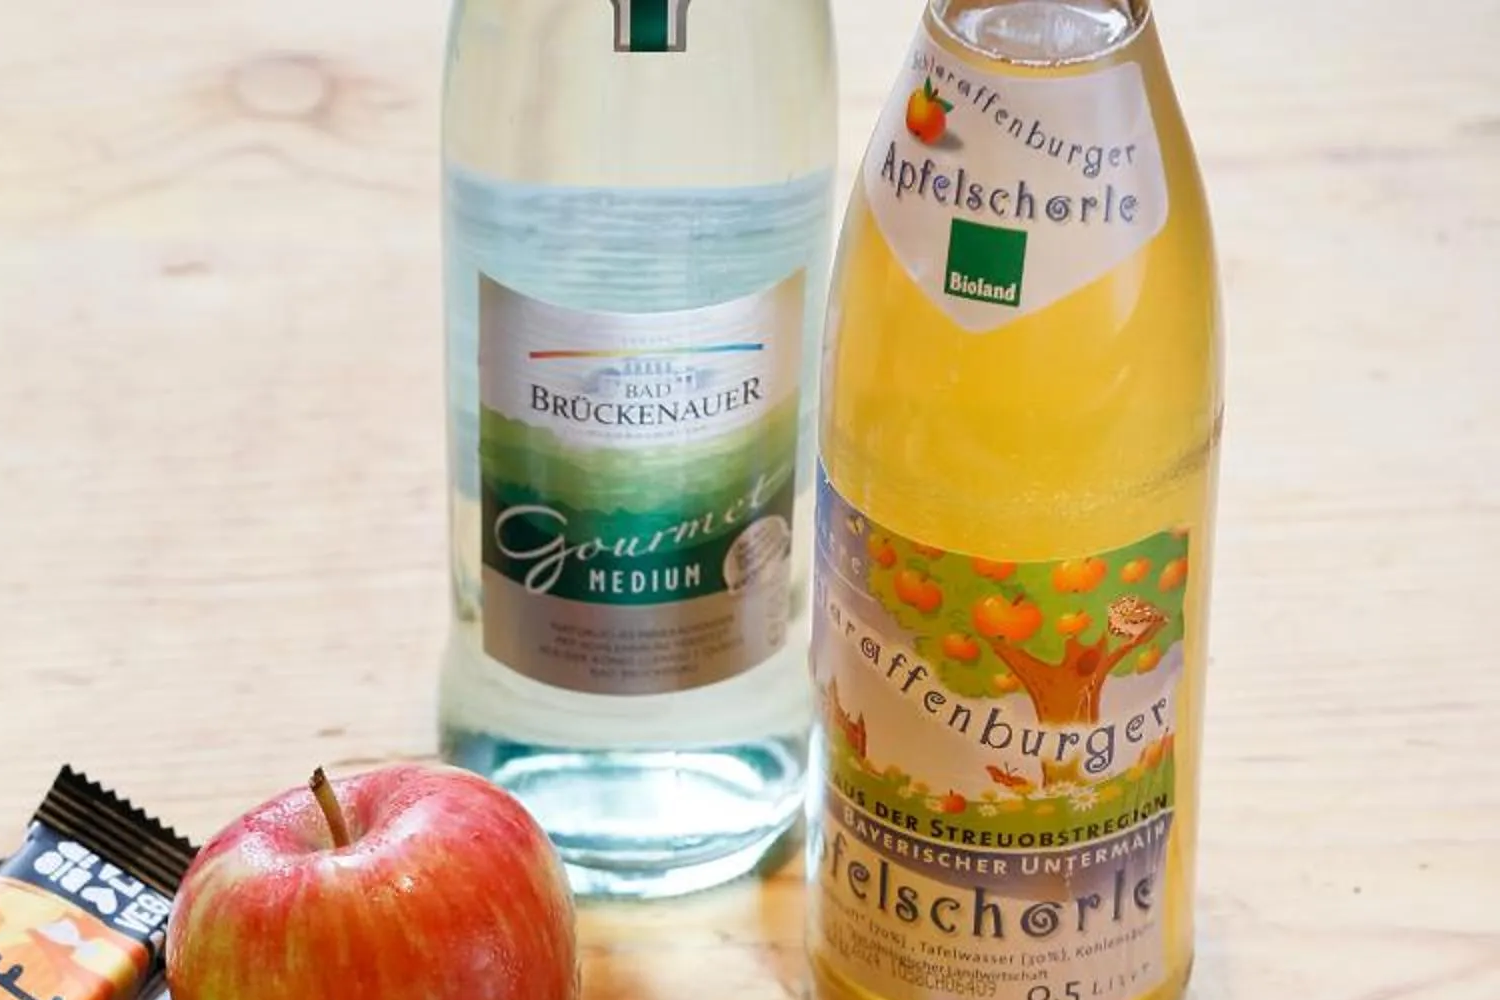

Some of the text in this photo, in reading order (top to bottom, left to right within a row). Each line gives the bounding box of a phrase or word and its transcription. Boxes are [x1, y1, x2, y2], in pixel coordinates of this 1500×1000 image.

[881, 141, 1140, 223] Apfelschorle
[950, 271, 1016, 302] Bioland
[530, 376, 764, 426] BRÜCKENAUER
[625, 383, 671, 399] BAD
[494, 466, 792, 595] Gourmet
[589, 563, 702, 594] MEDIUM
[843, 805, 1166, 876] BAYERISCHER UNTERMAIN
[875, 802, 919, 832] DER
[930, 793, 1169, 848] STREUOBSTREGION
[823, 832, 1158, 939] felschorle
[113, 892, 173, 934] VEG
[920, 941, 1014, 965] Tafelwasser
